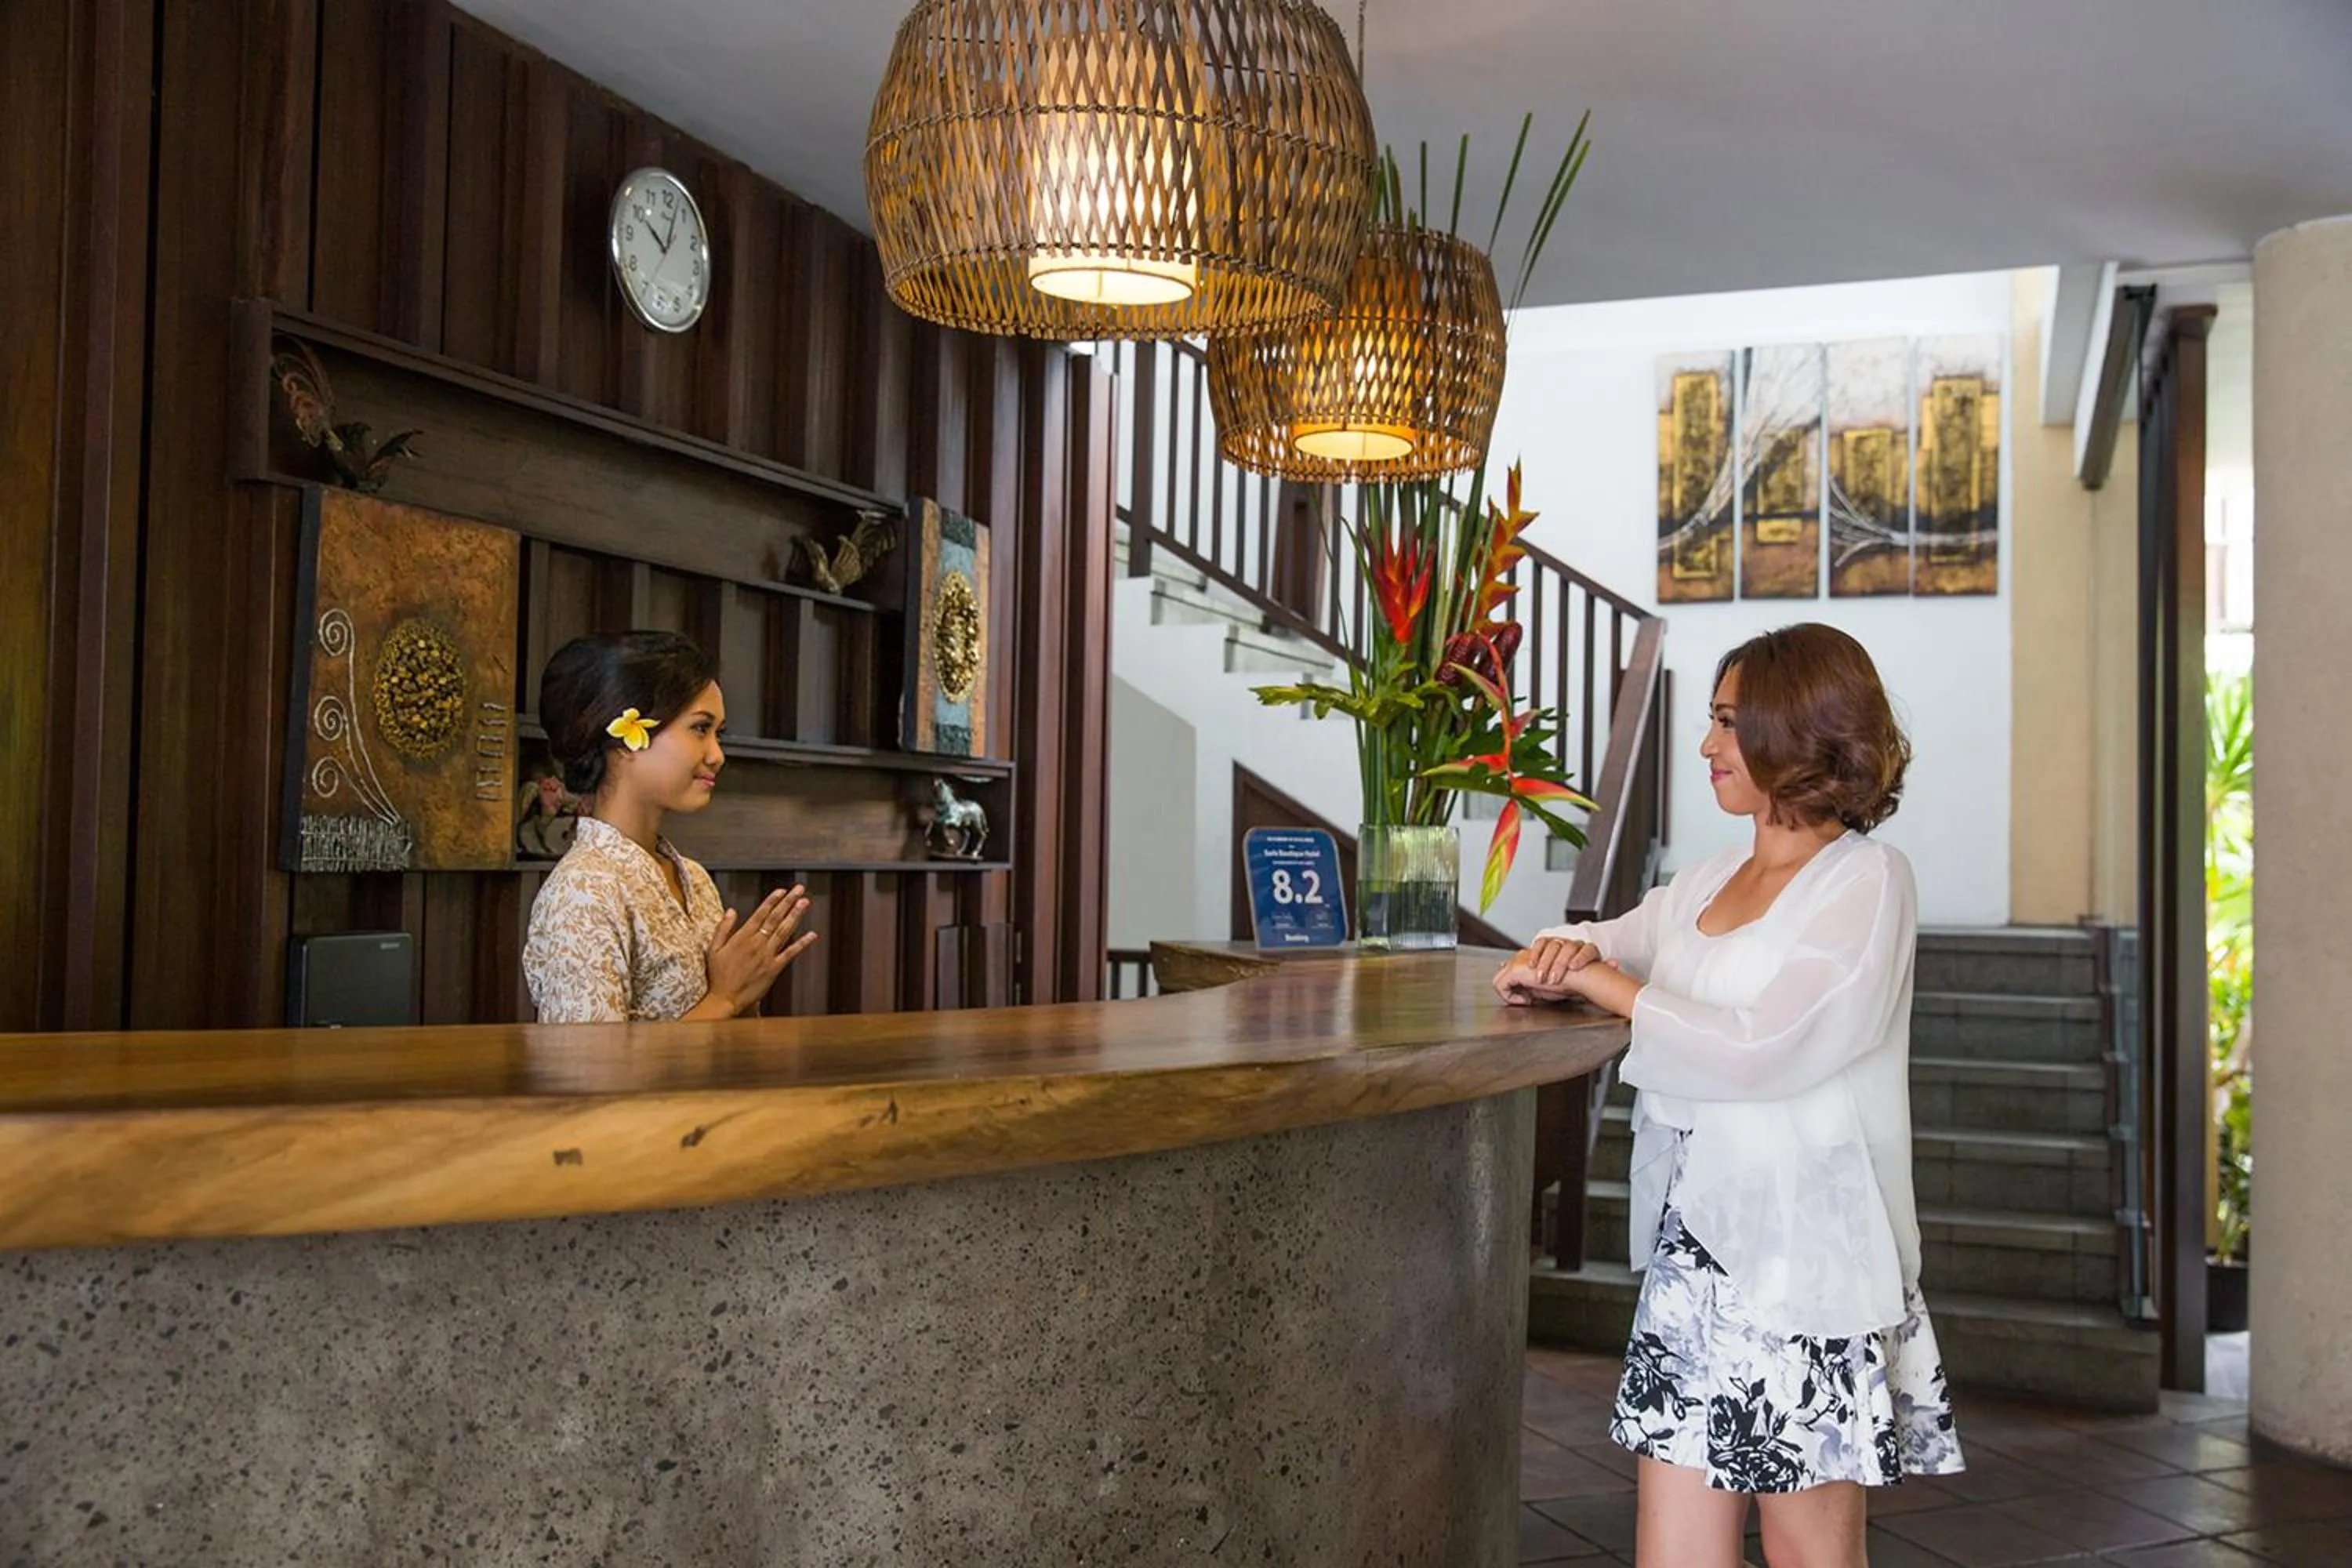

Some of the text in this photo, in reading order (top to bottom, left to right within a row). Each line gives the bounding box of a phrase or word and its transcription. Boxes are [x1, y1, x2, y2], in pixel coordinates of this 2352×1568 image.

[645, 188, 655, 207] 11
[662, 189, 674, 209] 12
[633, 204, 644, 223] 10
[626, 224, 633, 241] 9
[689, 233, 697, 252] 2
[630, 253, 637, 272] 8
[692, 259, 699, 276] 3
[1272, 869, 1323, 905] 8.2
